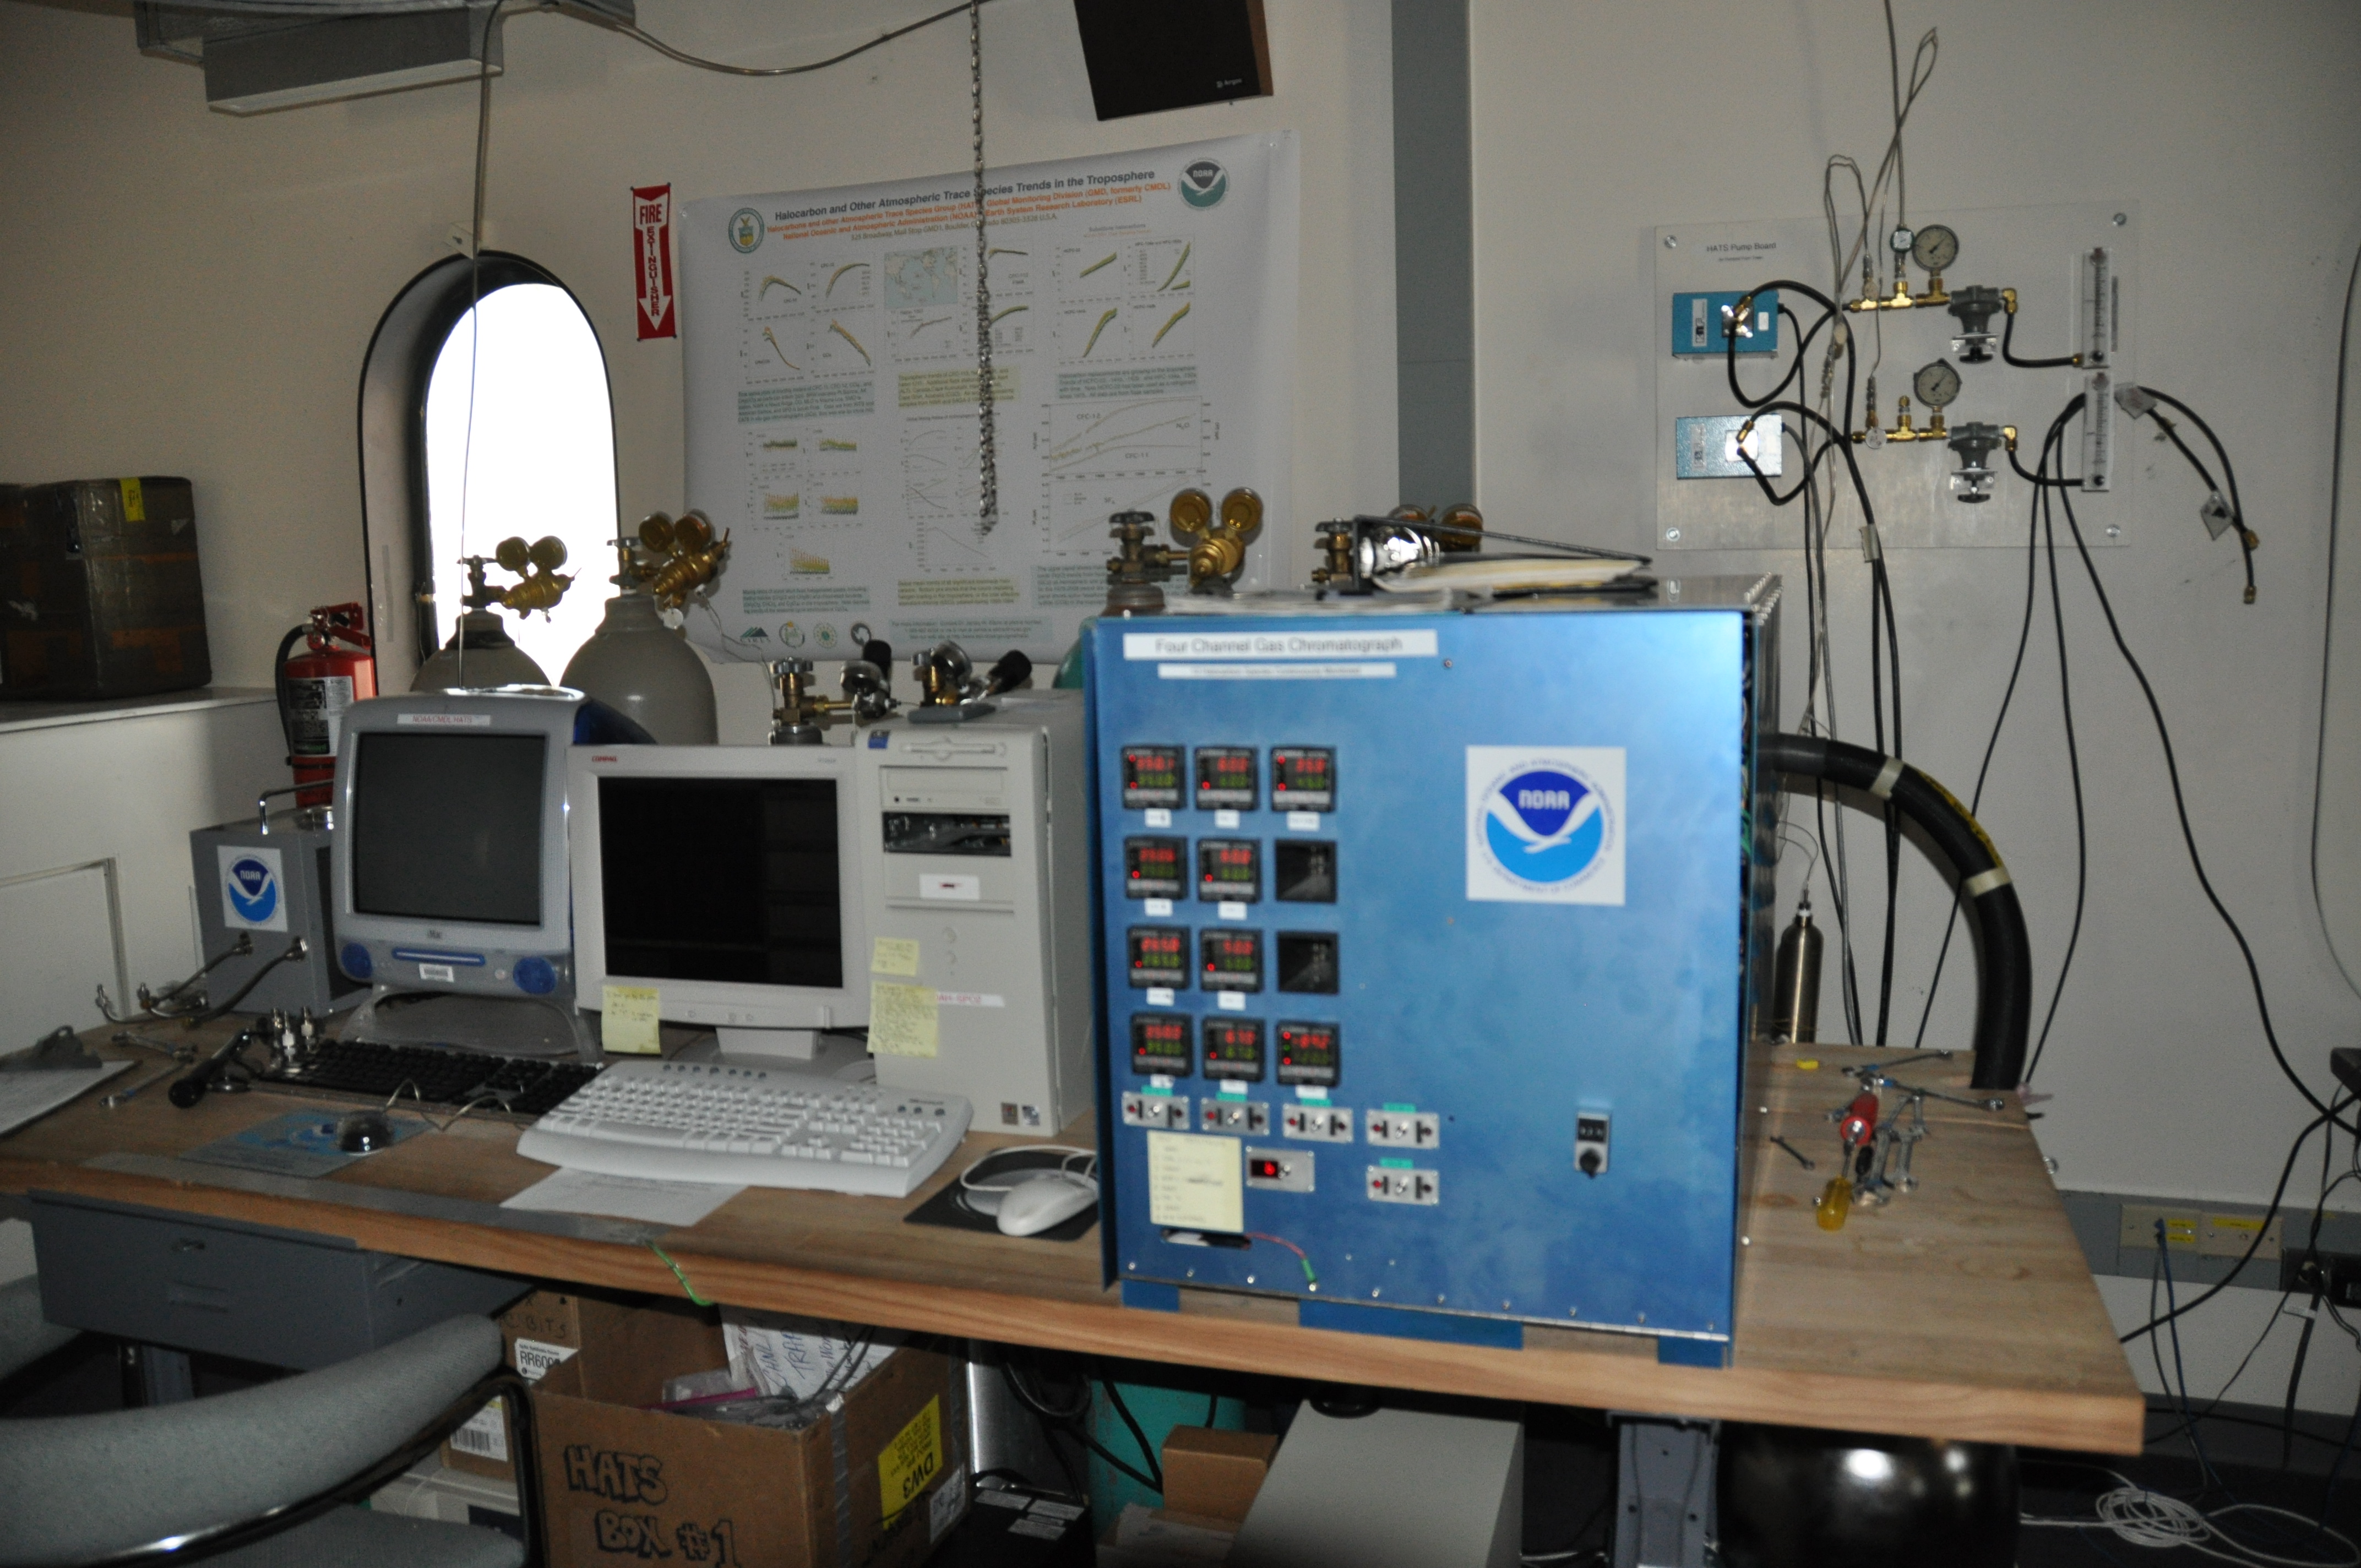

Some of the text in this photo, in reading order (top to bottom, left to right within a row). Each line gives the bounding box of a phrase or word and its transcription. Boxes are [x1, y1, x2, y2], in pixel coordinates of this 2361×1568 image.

[639, 204, 662, 225] FIRE
[767, 222, 807, 233] Halocarbons
[808, 219, 820, 227] and
[841, 211, 883, 224] Atmospheric
[905, 207, 933, 216] Species
[934, 204, 956, 213] Group
[987, 197, 1010, 207] Global
[1012, 194, 1051, 204] Monitoring
[1053, 190, 1083, 200] Division
[1111, 184, 1143, 194] formerly
[775, 206, 827, 221] Halocarbon
[829, 203, 847, 214] and
[850, 200, 875, 211] Other
[878, 193, 940, 208] Atmospheric
[943, 190, 971, 200] Trace
[1016, 180, 1051, 193] Trends
[1054, 178, 1064, 188] in
[1068, 177, 1084, 187] the
[1087, 170, 1155, 186] Troposphere
[783, 231, 809, 240] National
[811, 228, 836, 237] Oceanic
[853, 220, 895, 231] Atmospheric
[897, 215, 948, 226] Administration
[985, 208, 1005, 216] Earth
[1007, 205, 1034, 215] System
[1036, 203, 1069, 211] Research
[1072, 197, 1112, 208] Laboratory
[1115, 194, 1143, 205] (ESRL)
[646, 226, 660, 317] EXTINGUISHER
[1706, 243, 1729, 253] HATS
[1731, 243, 1752, 251] Pump
[1155, 636, 1403, 654] Four Channel Gas Chromatograph
[564, 1442, 668, 1505] HATS
[901, 1451, 935, 1501] DW3
[594, 1509, 744, 1568] BOX #1
